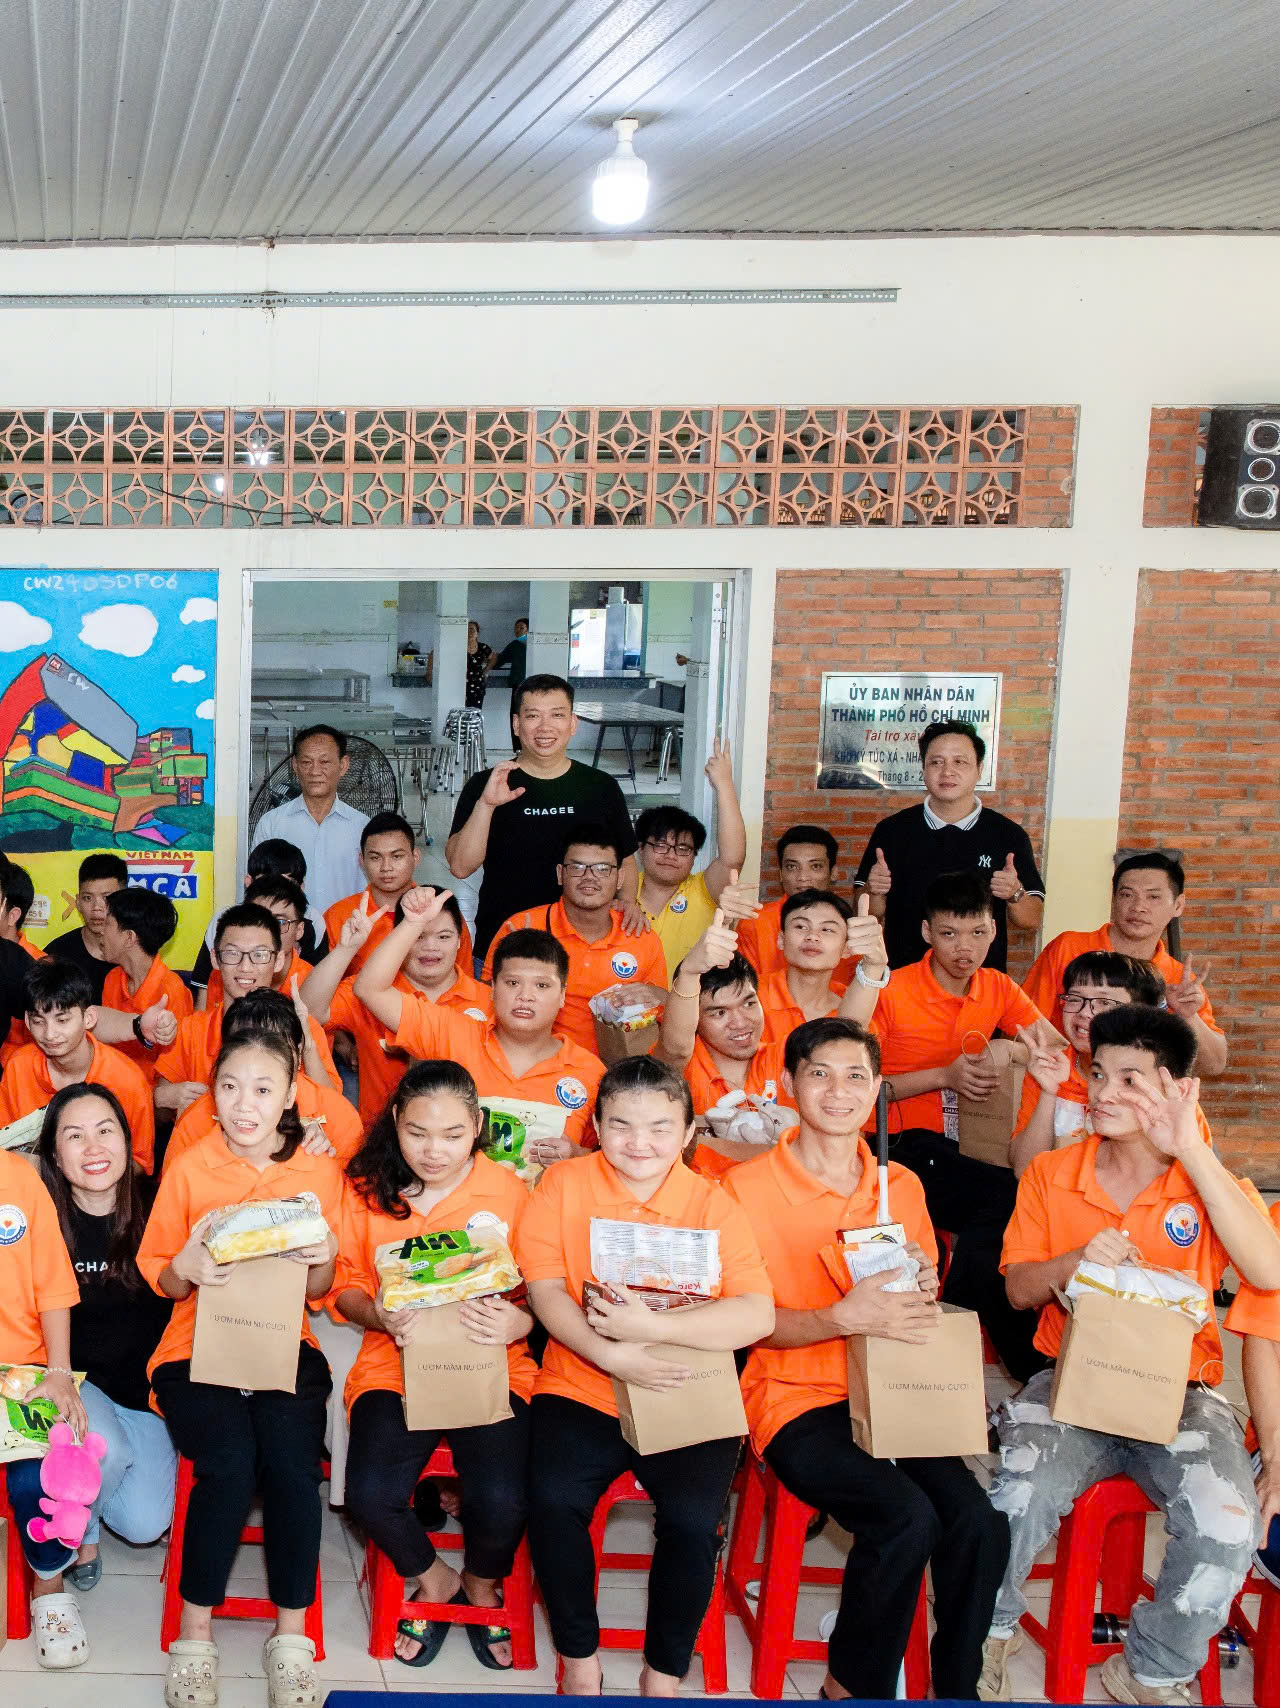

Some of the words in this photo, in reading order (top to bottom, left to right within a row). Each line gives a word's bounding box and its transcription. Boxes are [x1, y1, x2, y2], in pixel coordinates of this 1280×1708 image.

[849, 683, 868, 700] ỦY
[872, 688, 900, 700] BAN
[903, 685, 944, 701] NHÂN
[946, 686, 975, 701] DÂN
[832, 705, 875, 722] THÀNH
[879, 704, 906, 722] PHỐ
[909, 704, 928, 722] HỒ
[931, 706, 953, 723] CHÍ
[956, 710, 990, 722] MINH
[524, 806, 574, 816] CHAGEE
[126, 851, 194, 859] VIETNAM
[128, 877, 192, 897] MCA
